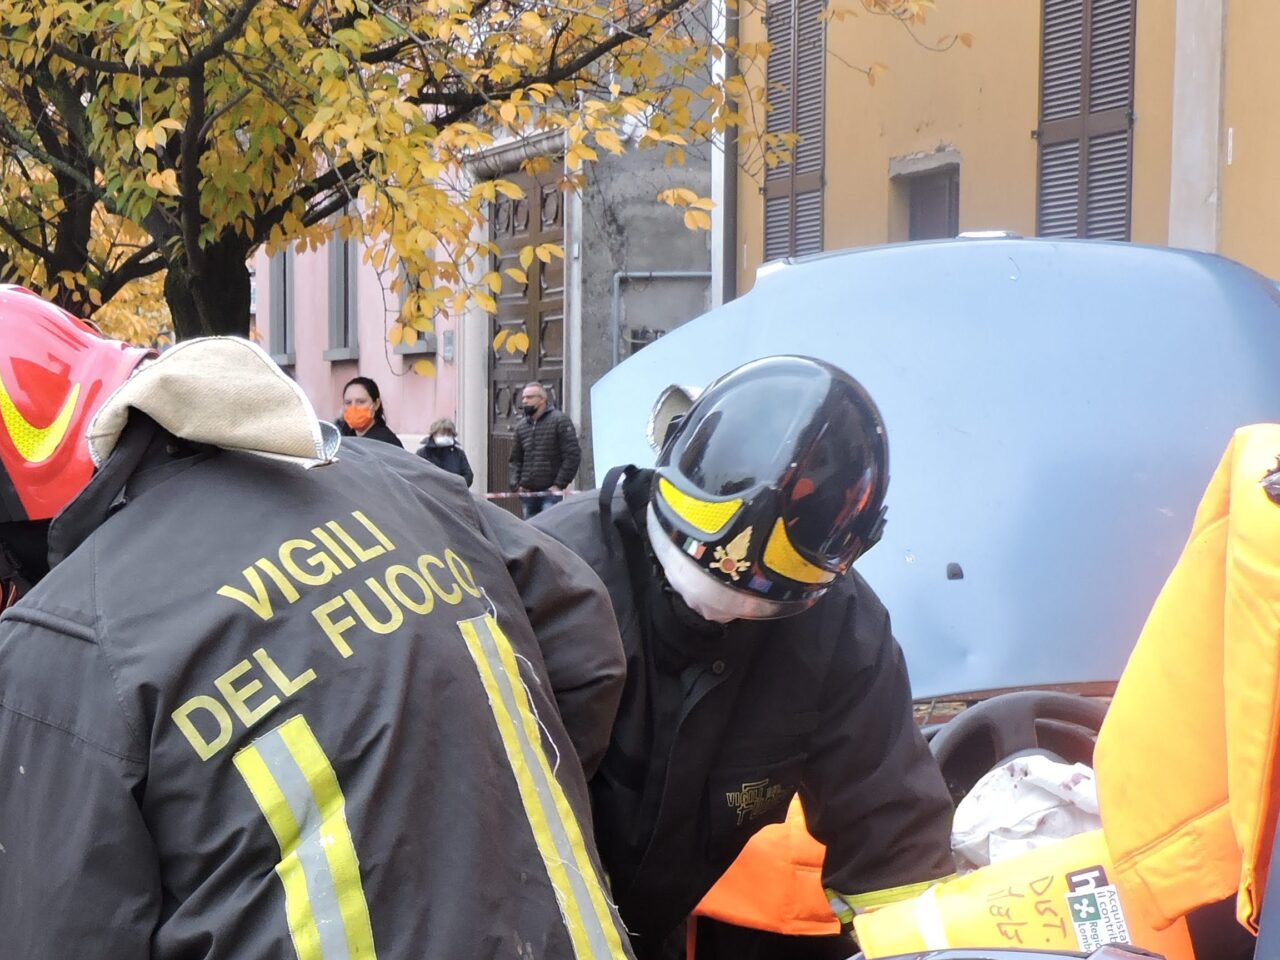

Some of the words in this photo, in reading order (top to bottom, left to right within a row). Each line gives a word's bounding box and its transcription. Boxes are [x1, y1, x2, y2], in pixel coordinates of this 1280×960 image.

[216, 510, 396, 621] VIGILI
[171, 647, 317, 762] DEL
[311, 548, 481, 659] FUOCO
